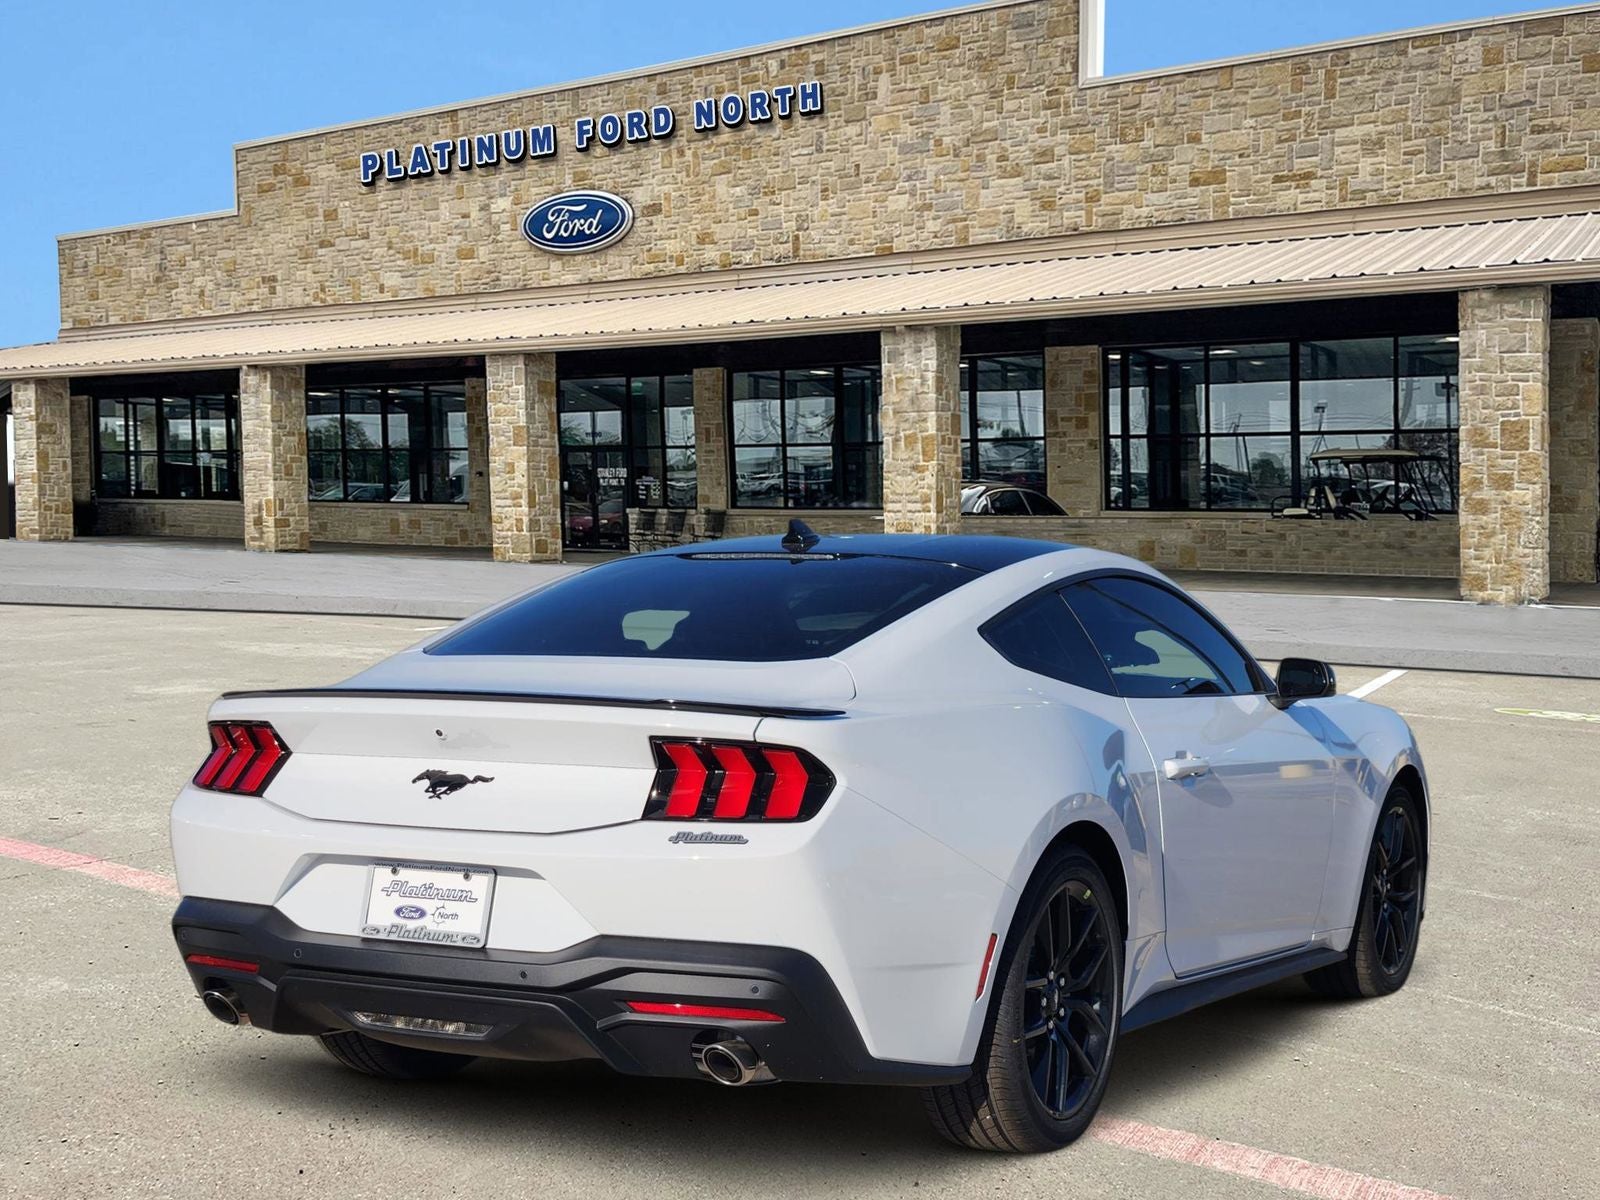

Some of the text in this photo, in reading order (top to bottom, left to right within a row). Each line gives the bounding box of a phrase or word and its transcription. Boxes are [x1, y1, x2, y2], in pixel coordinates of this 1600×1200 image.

[360, 80, 824, 187] PLATINUM FORD NORTH
[541, 204, 602, 239] Ford
[668, 831, 749, 844] Platinum
[374, 862, 489, 874] www.PlatinumFordNorth.com
[381, 880, 478, 903] Platinum
[400, 906, 420, 918] Ford
[438, 911, 459, 921] North
